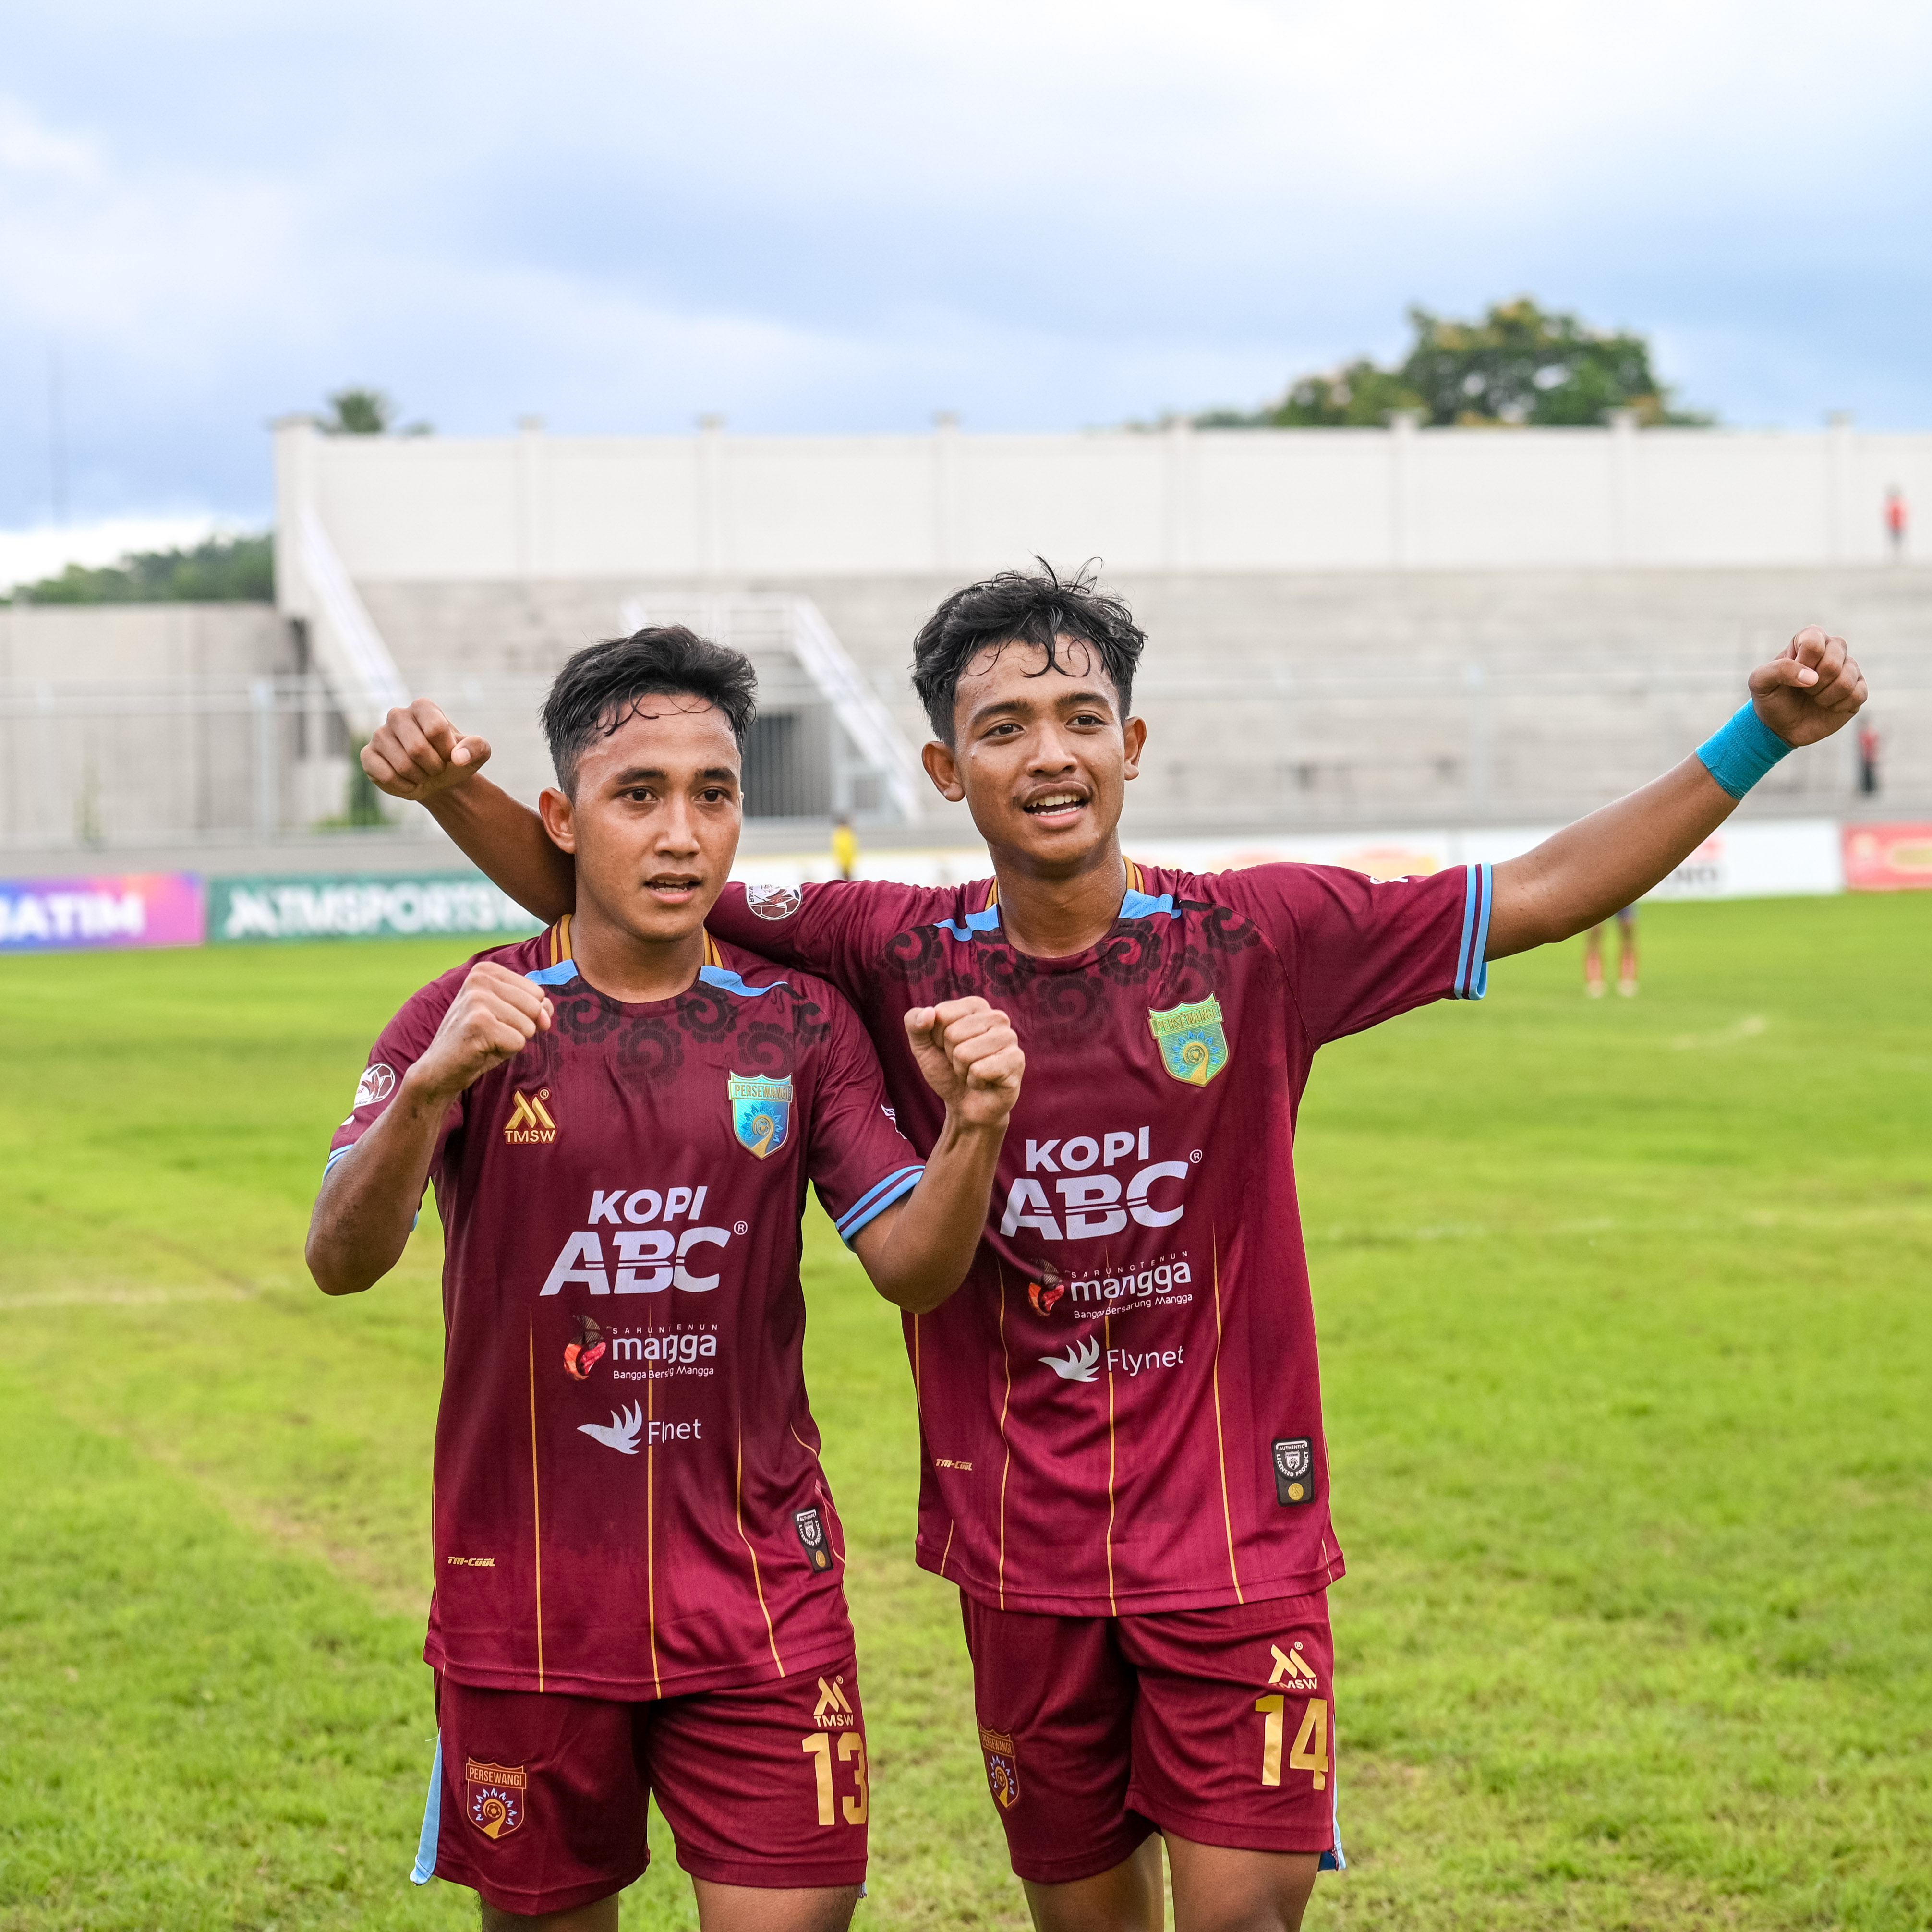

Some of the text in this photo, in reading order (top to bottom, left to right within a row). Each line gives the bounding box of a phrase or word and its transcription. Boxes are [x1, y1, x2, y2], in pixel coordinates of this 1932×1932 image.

[1156, 1008, 1217, 1032] PERSEWANGI
[735, 1084, 791, 1099] PERSEWANGI
[505, 1130, 555, 1143] TMSW
[1026, 1126, 1149, 1172] KOPI
[588, 1186, 708, 1224] KOPI
[1000, 1160, 1188, 1240] ABC
[539, 1226, 731, 1296] ABC
[1071, 1261, 1192, 1301] mangga
[1105, 1299, 1151, 1315] Bersarung
[1155, 1294, 1193, 1305] Mangga
[614, 1370, 646, 1380] Bangga
[676, 1366, 714, 1377] Mangga
[1107, 1345, 1183, 1376] Flynet
[648, 1419, 701, 1445] Flnet
[1276, 1451, 1309, 1477] LICENSED PRODUCT
[1271, 1678, 1317, 1690] MSW
[813, 1714, 854, 1727] TMSW
[1255, 1694, 1329, 1790] 14
[470, 1767, 522, 1786] PERSEWANGI
[802, 1732, 867, 1825] 13
